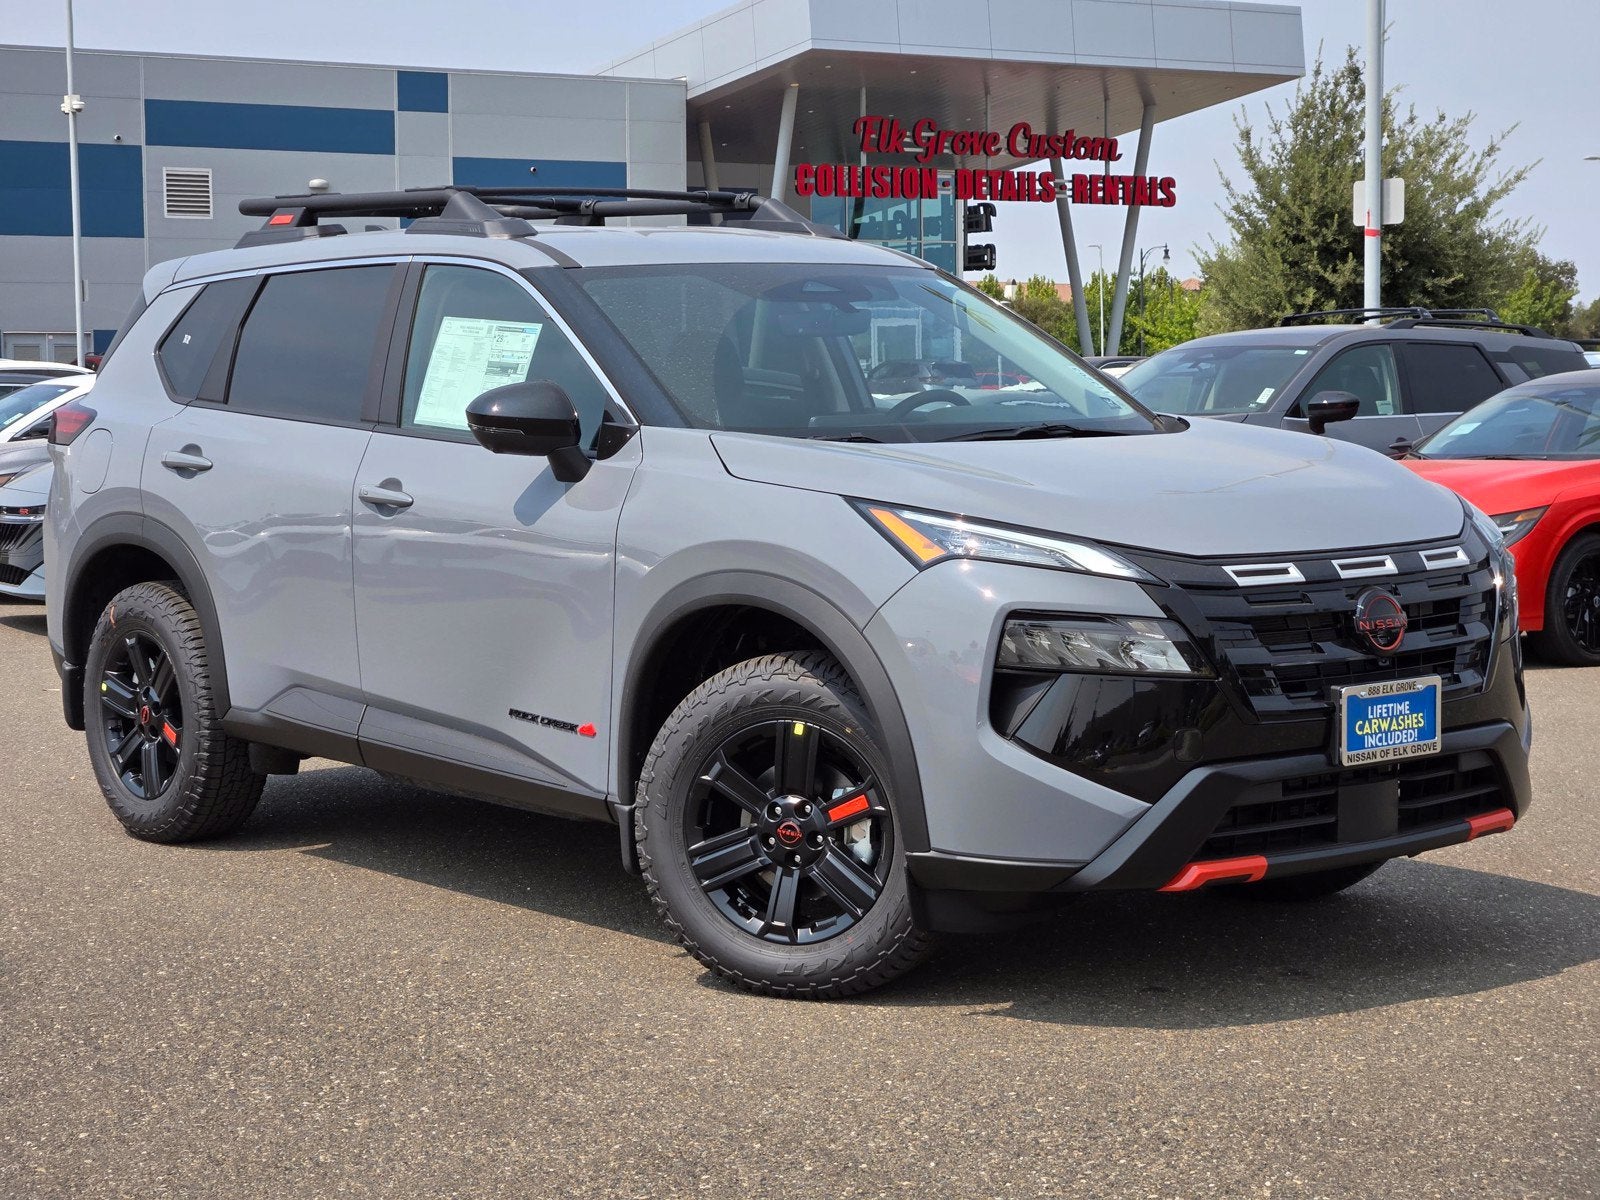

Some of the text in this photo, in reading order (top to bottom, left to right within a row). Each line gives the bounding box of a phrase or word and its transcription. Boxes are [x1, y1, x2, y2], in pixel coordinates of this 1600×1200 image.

[853, 115, 1123, 163] Elk Grove Custom
[795, 163, 1177, 208] COLLISION DETAILS RENTALS
[1359, 617, 1408, 631] NISSAN
[1367, 681, 1417, 696] 888 ELK GROVE
[508, 708, 579, 732] ROCK CREEK
[1368, 701, 1410, 718] LIFETIME
[1355, 713, 1424, 735] CARWASHES
[1364, 729, 1418, 748] INCLUDED!
[1347, 741, 1438, 764] NISSAN OF ELK GROVE
